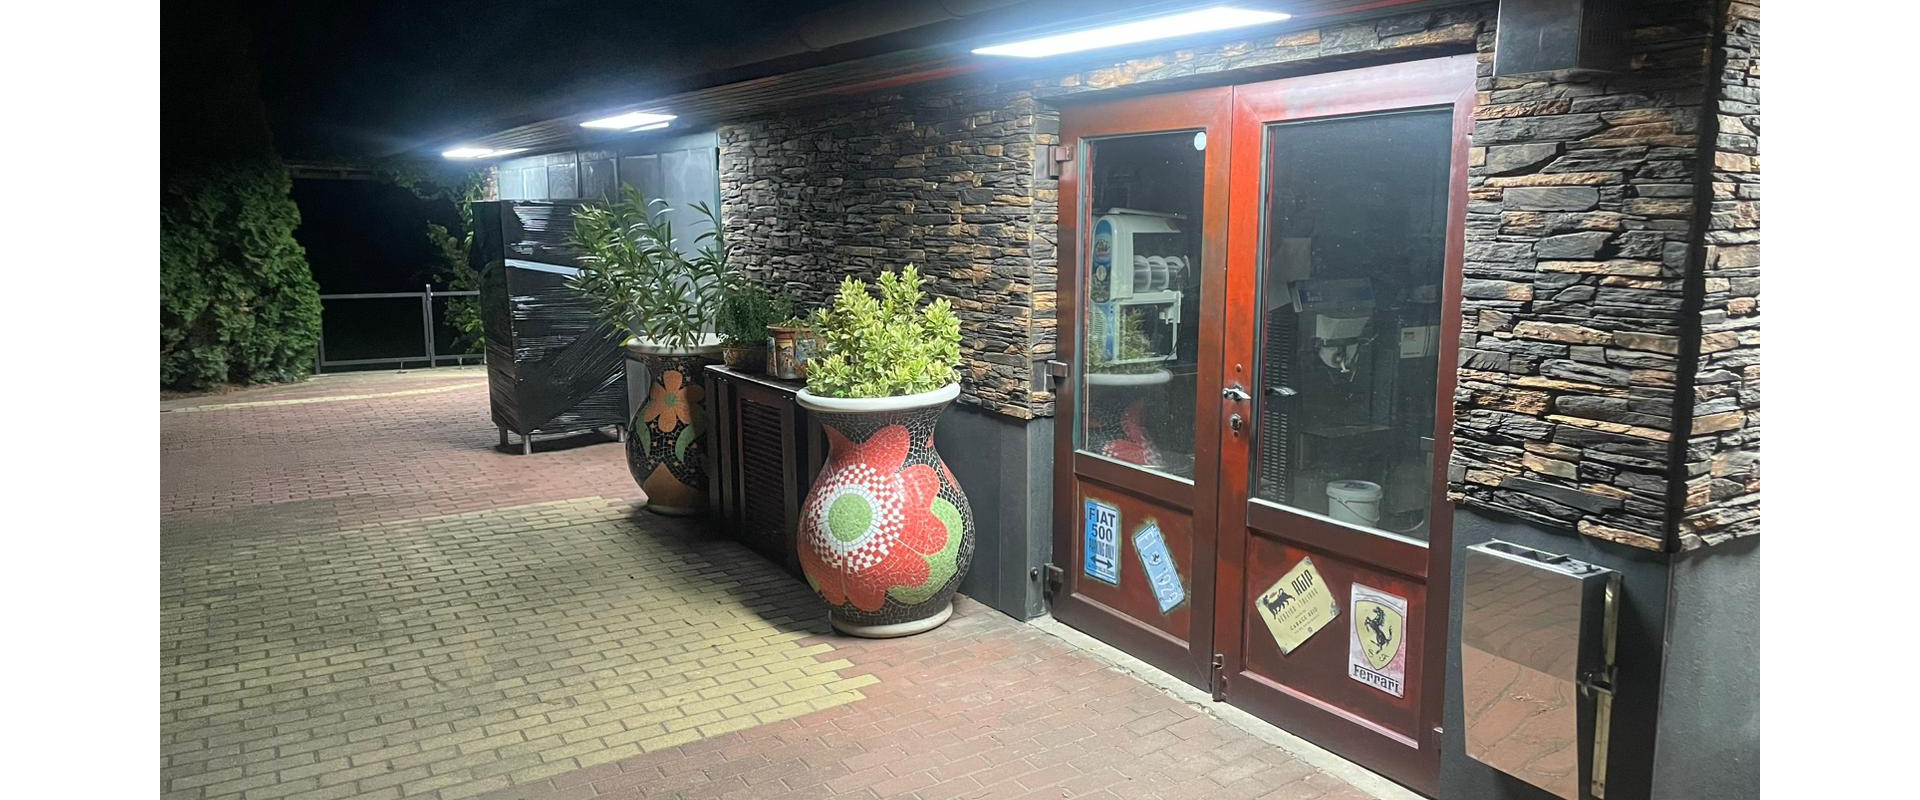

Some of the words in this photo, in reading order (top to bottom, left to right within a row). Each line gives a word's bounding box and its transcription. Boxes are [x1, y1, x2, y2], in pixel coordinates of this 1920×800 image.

[1089, 507, 1115, 527] FIAT
[1092, 524, 1113, 542] 500
[1291, 569, 1313, 596] AGIP
[1353, 664, 1401, 694] Ferrari
